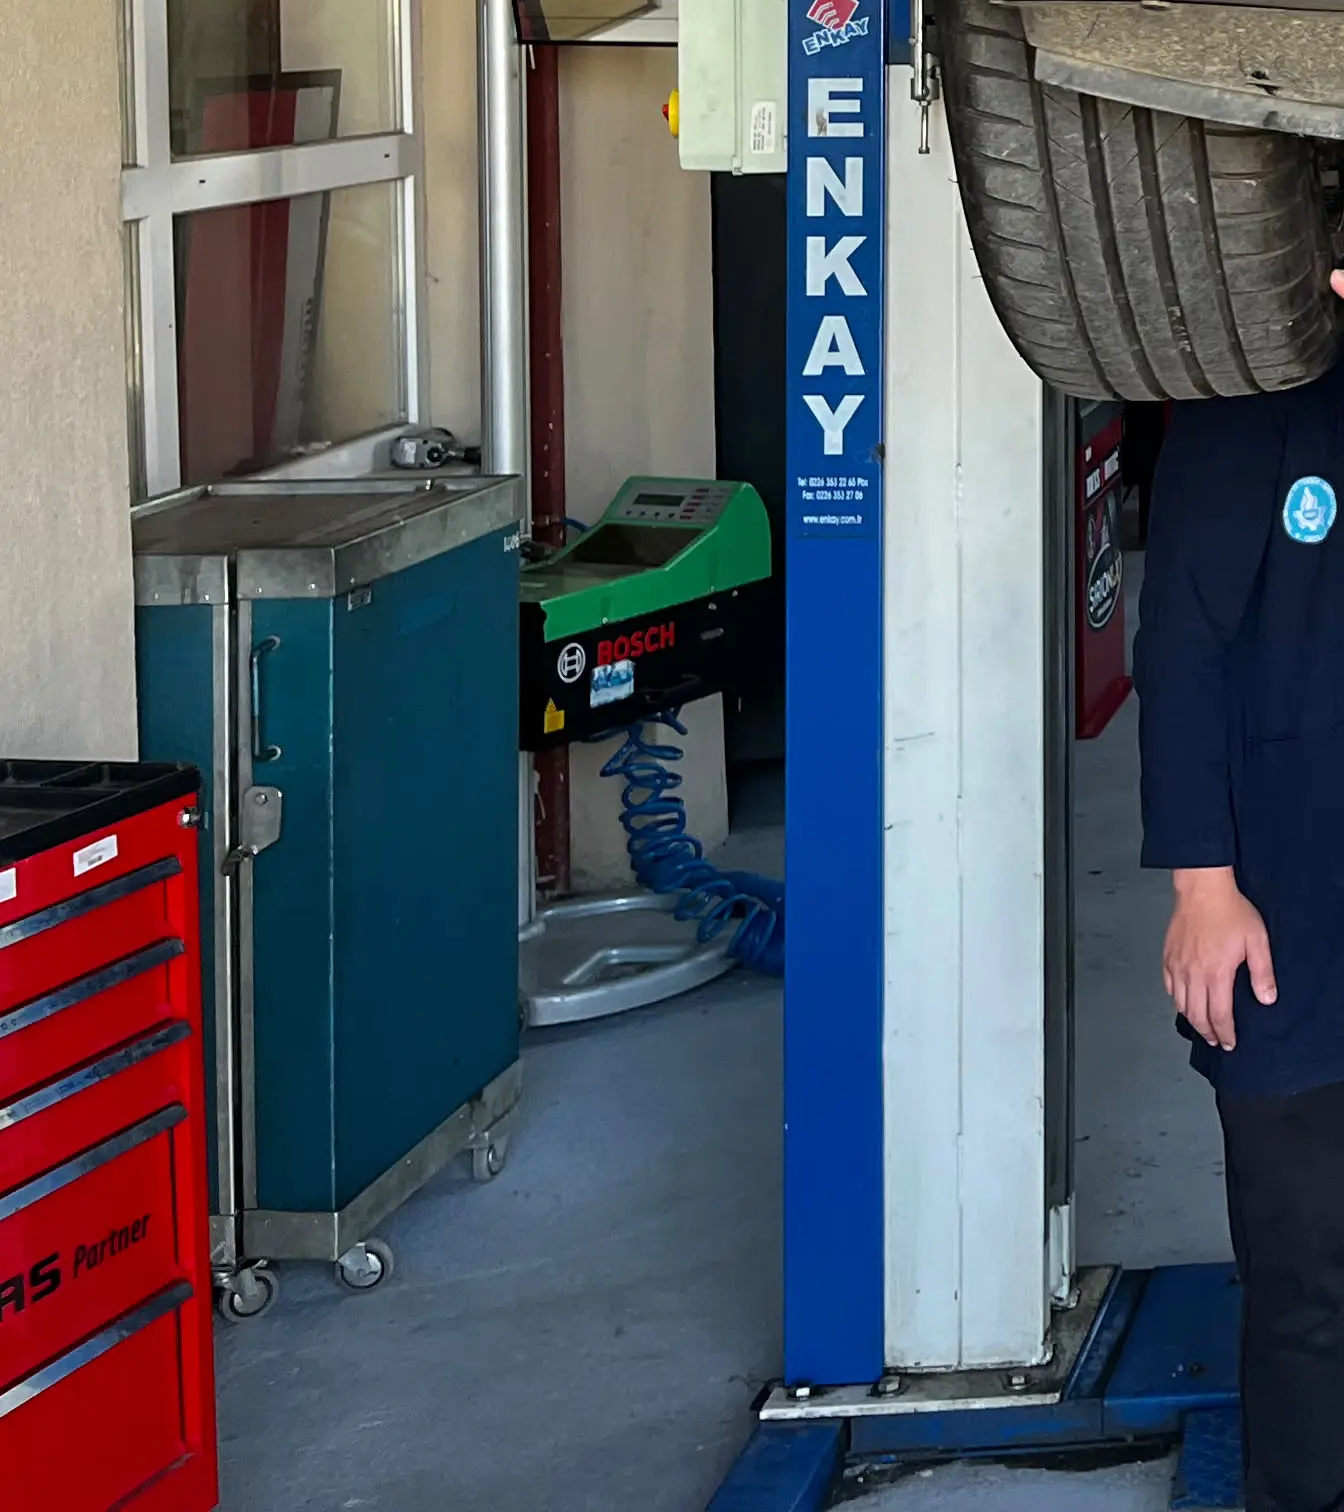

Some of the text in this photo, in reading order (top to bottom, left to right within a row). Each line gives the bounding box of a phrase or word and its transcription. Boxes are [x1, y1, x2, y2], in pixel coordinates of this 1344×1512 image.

[802, 16, 870, 56] ENKAY
[802, 77, 868, 456] ENKAY
[597, 621, 675, 666] BOSCH
[73, 1213, 150, 1279] Partner
